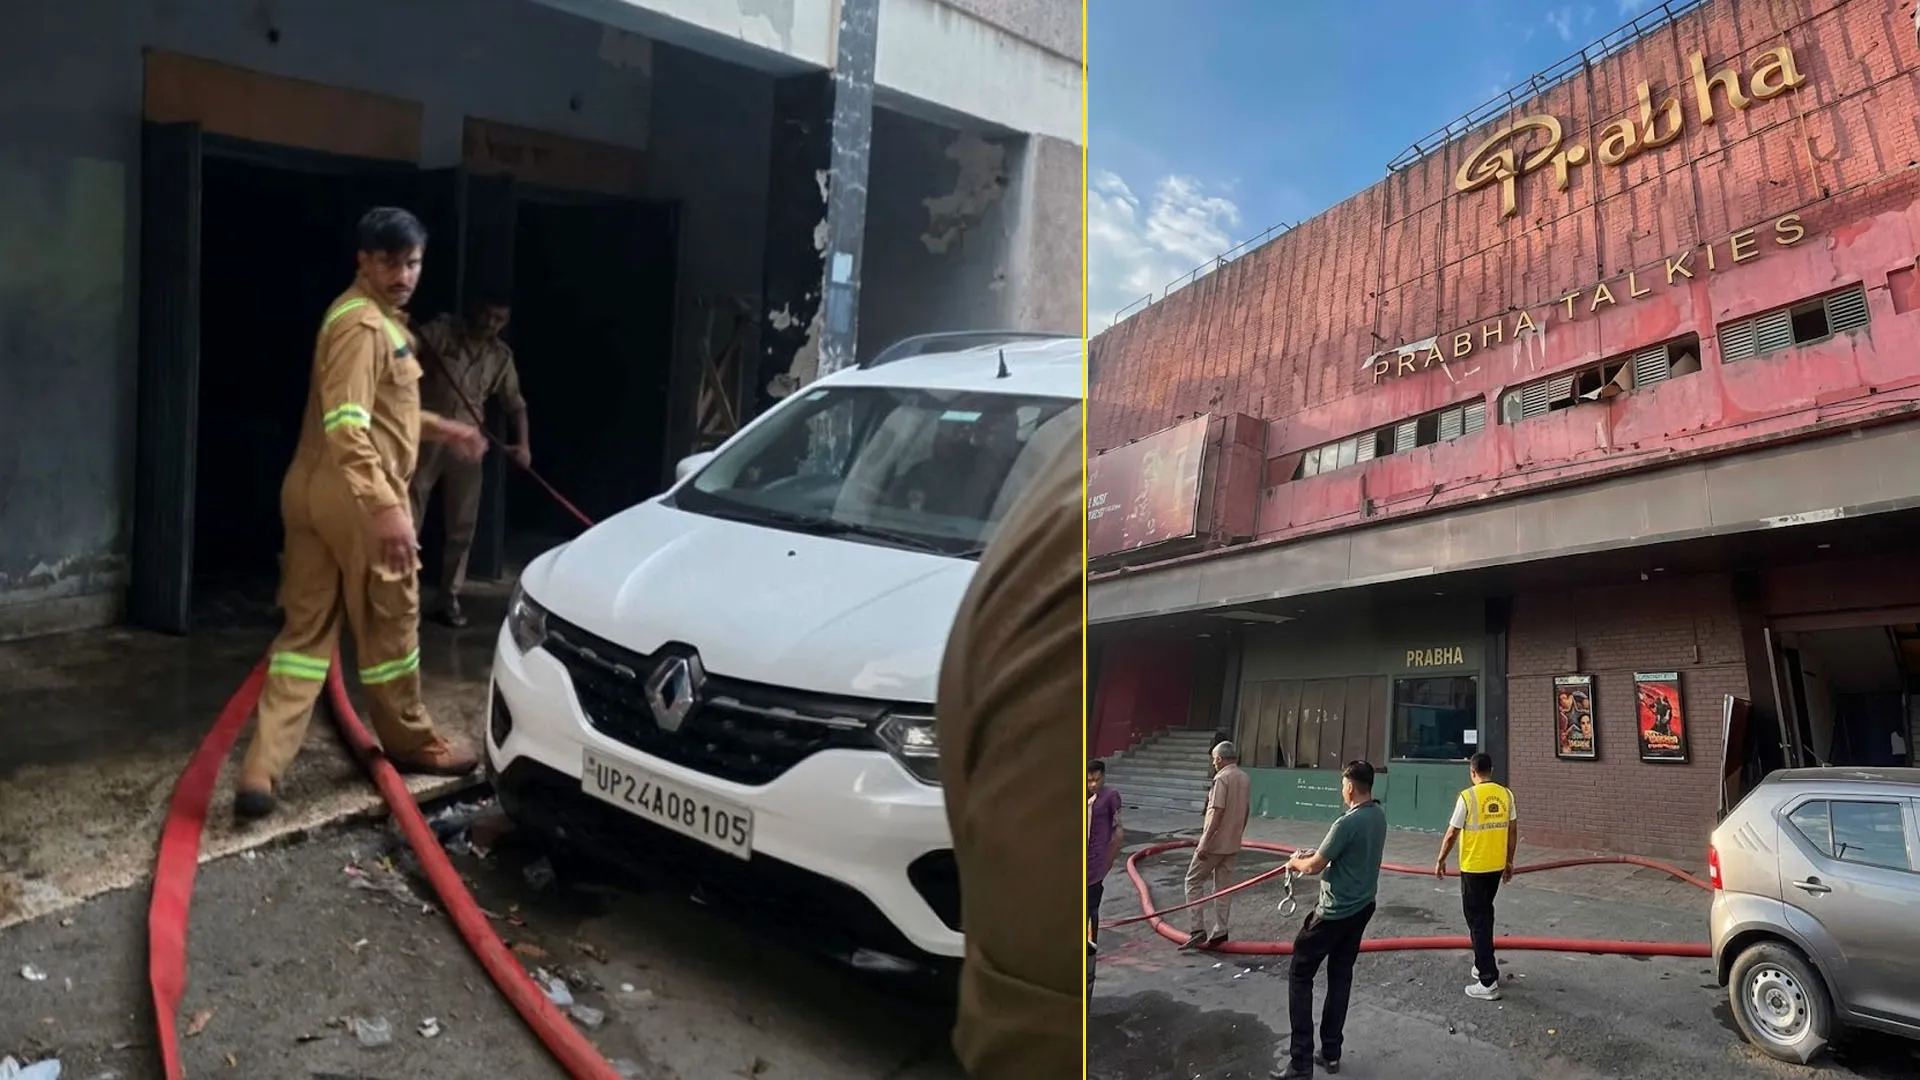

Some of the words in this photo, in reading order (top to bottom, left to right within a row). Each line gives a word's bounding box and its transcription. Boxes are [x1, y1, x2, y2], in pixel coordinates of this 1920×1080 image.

[1455, 46, 1805, 217] Prabha
[1372, 311, 1537, 385] PRABHA
[1560, 214, 1804, 320] TALKIES
[1406, 646, 1464, 668] PRABHA
